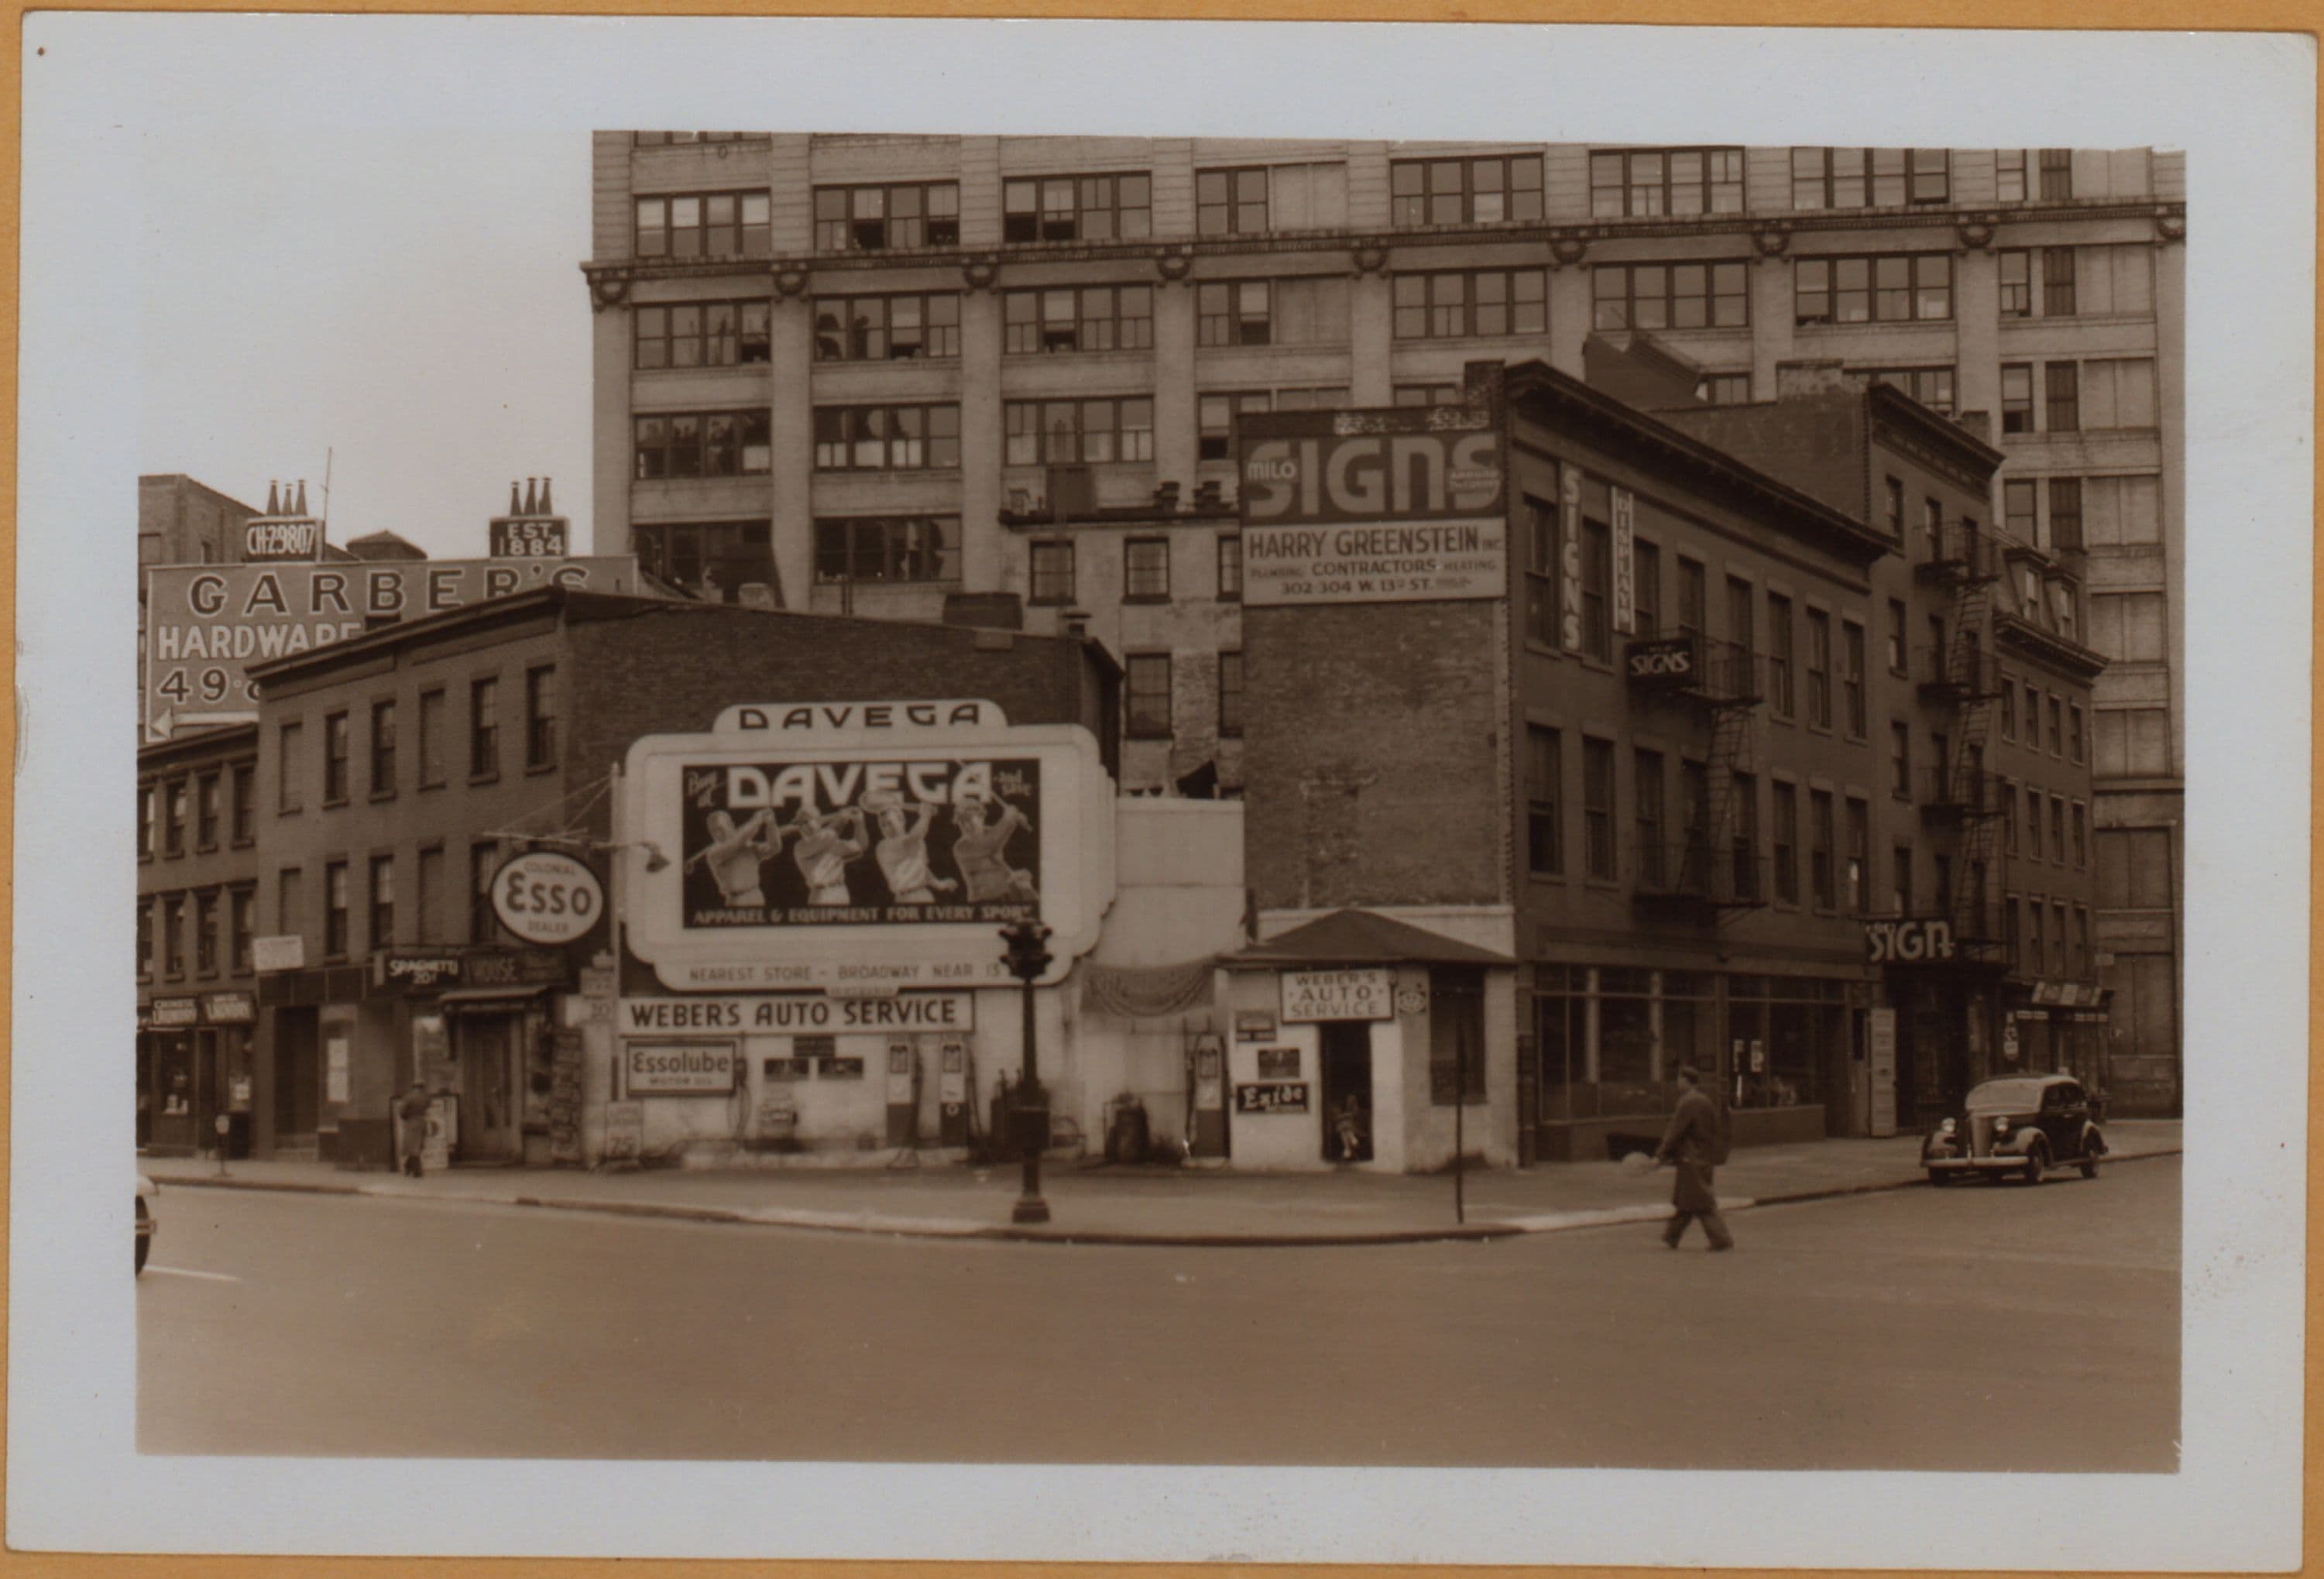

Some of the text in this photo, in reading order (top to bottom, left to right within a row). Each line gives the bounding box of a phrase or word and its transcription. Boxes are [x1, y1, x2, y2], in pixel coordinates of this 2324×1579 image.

[499, 534, 563, 555] 1884
[1249, 532, 1327, 559] HARRY
[1335, 525, 1480, 557] GREENSTEIN
[1312, 557, 1436, 578] CONTRACTORS
[1561, 466, 1581, 650] SIGNS
[1629, 650, 1691, 675] SIGNS
[739, 702, 980, 730] DAVEGA
[726, 760, 992, 808] DAVEGA
[693, 908, 766, 925] APPAREL
[788, 908, 879, 923] EQUIPMENT
[886, 907, 919, 922] FOR
[925, 905, 976, 921] EVERY
[690, 969, 754, 983] NEAREST
[764, 967, 812, 982] STORE
[838, 965, 919, 980] BROADWAY
[932, 964, 973, 978] NEAR
[1296, 973, 1377, 987] WEBER'S
[1299, 986, 1371, 1002] AUTO
[631, 1002, 740, 1028] WEBER'S
[754, 1002, 830, 1026] AUTO
[843, 998, 956, 1025] SERVICE
[1291, 1002, 1377, 1018] SERVICE
[632, 1052, 729, 1074] Essolube
